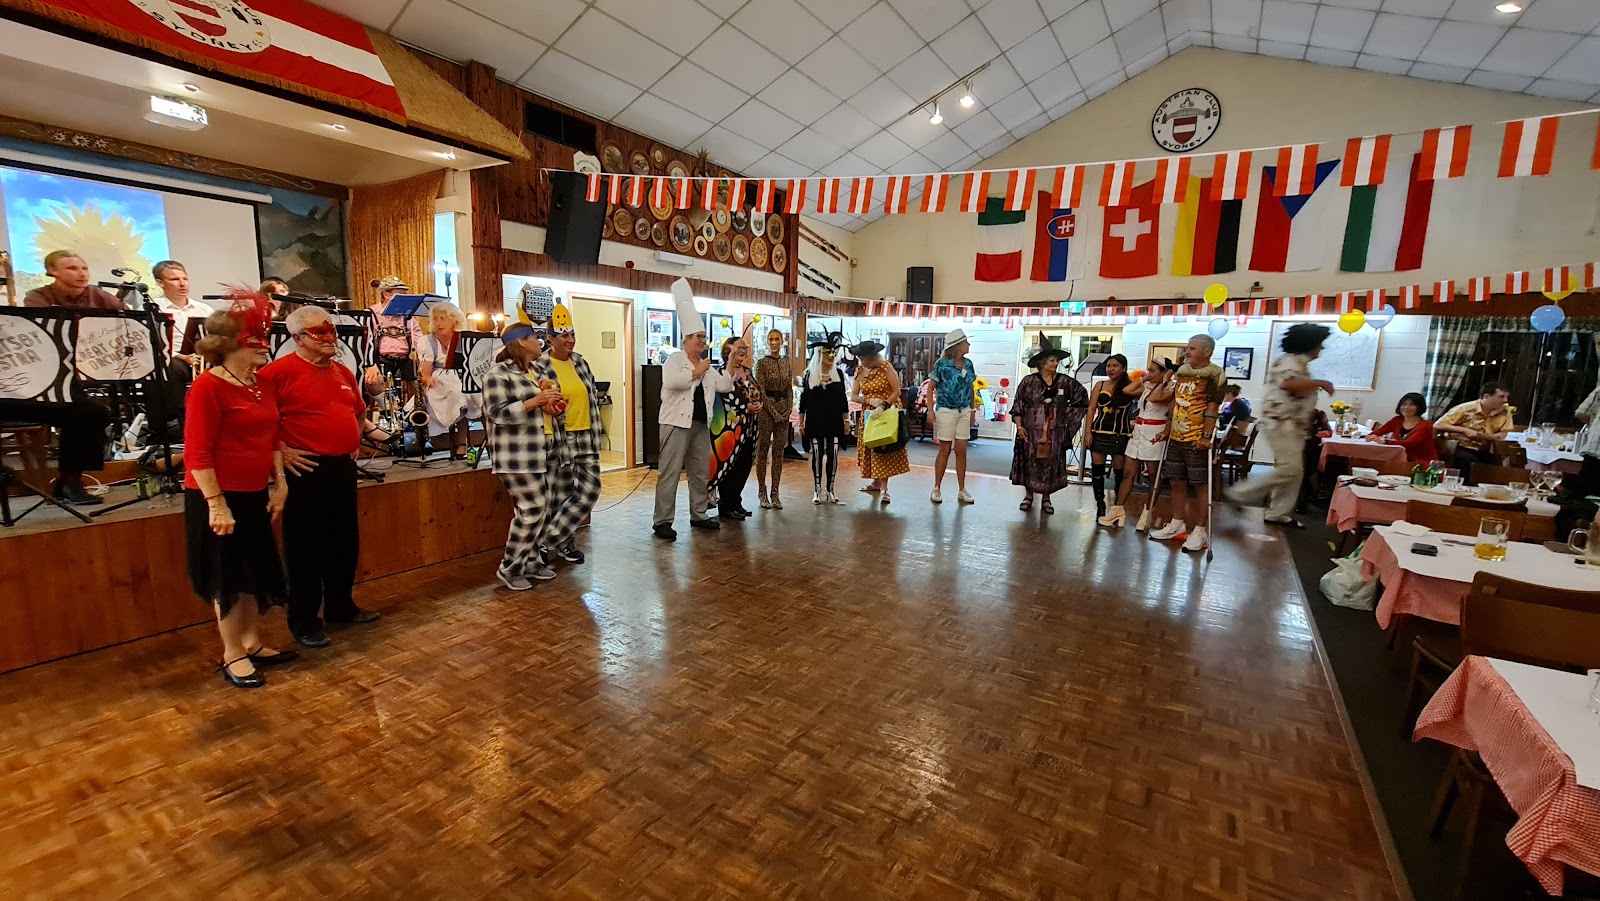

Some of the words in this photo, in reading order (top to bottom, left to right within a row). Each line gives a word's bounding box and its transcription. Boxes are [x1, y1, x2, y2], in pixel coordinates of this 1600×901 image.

[152, 11, 252, 51] SYDNEY
[1155, 90, 1201, 123] AUSTRIAN
[1204, 94, 1219, 117] CLUB
[1162, 137, 1202, 150] SYDNEY
[88, 341, 148, 370] ORCHERA
